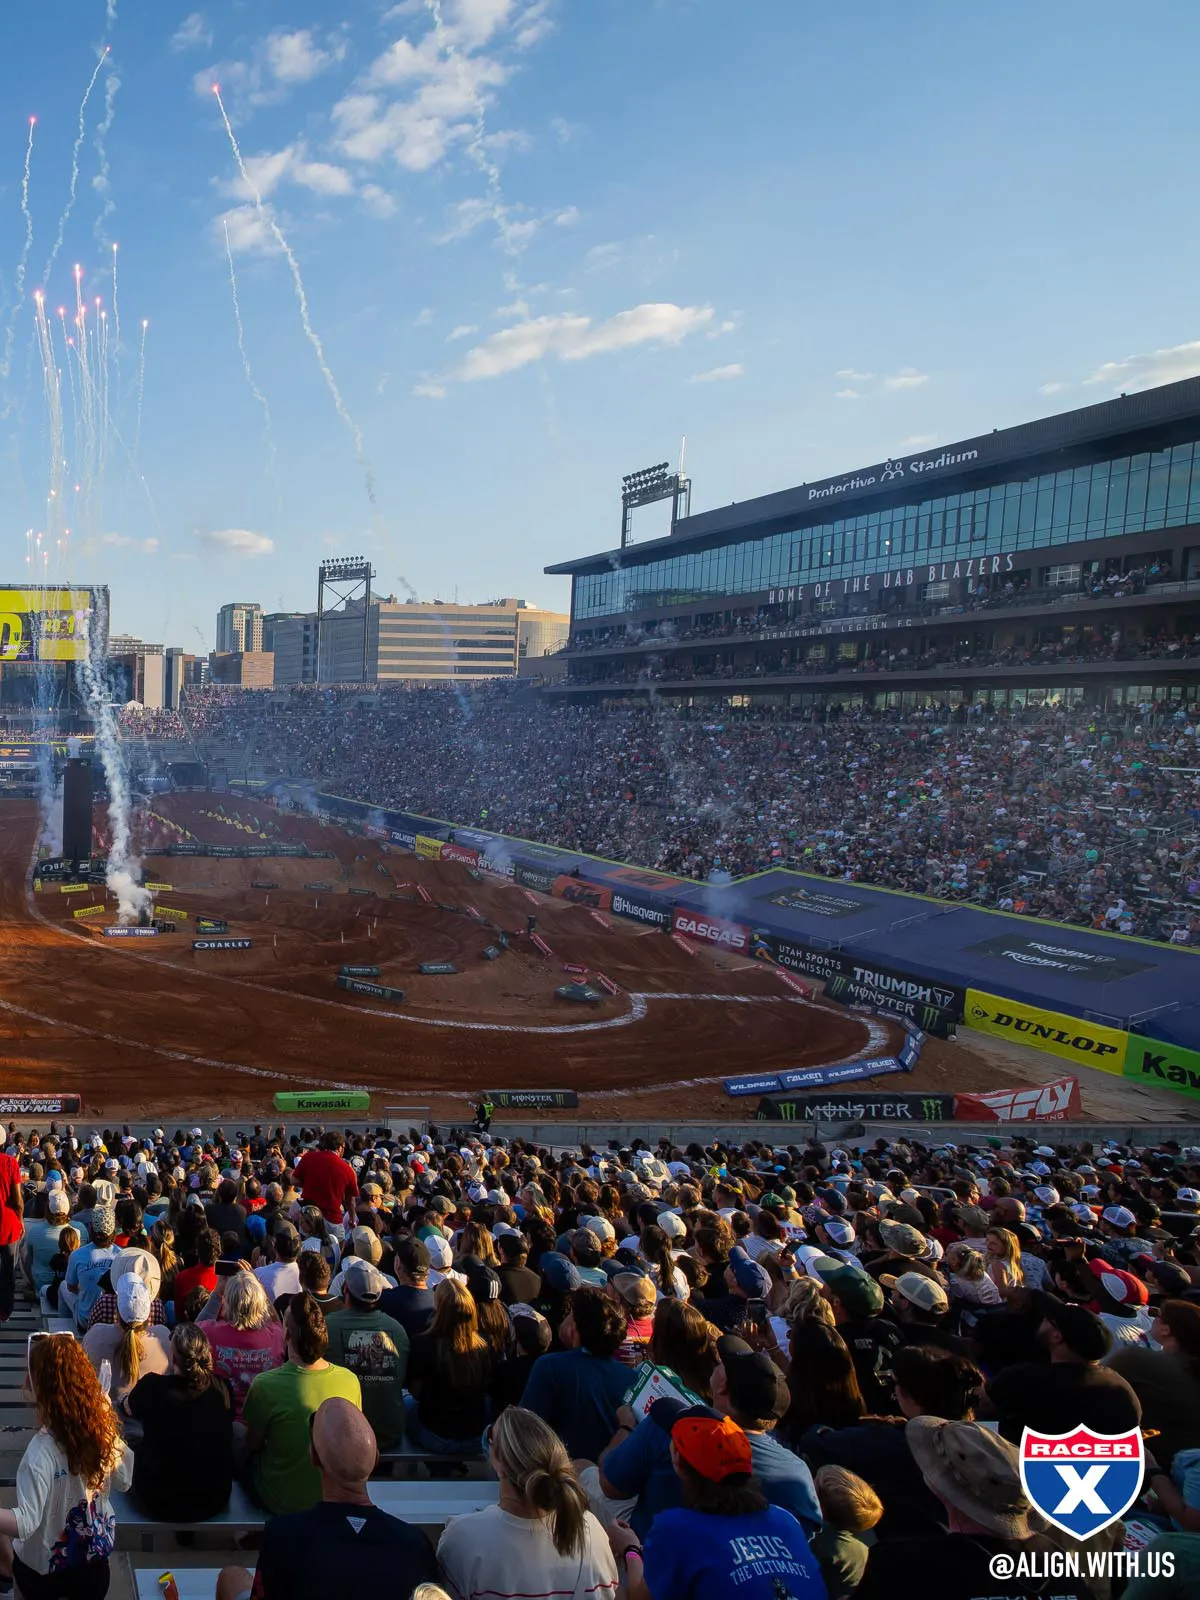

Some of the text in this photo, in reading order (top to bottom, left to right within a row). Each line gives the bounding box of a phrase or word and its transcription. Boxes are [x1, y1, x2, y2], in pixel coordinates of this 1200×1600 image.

[808, 449, 978, 500] Protective Stadium
[769, 554, 1014, 604] HOME OF THE UAB BLAZERS
[760, 619, 912, 640] BIRMINGHAM LEGION FC
[621, 898, 667, 923] Husqvarn
[210, 941, 250, 949] OAKLEY
[675, 916, 747, 948] GASGAS
[779, 944, 841, 970] UTAH SPORTS
[1001, 949, 1068, 969] TRIUMPH
[1026, 941, 1094, 961] TRIUMPH
[777, 954, 832, 979] COMMISSIO
[853, 966, 932, 1003] TRIUMPH
[848, 983, 916, 1017] MONSTER
[991, 1012, 1118, 1056] DUNLOP
[730, 1081, 777, 1090] WILDPEAK
[786, 1072, 822, 1082] FALKEN
[867, 1059, 896, 1069] FALKEN
[297, 1099, 351, 1109] Kawasaki
[511, 1094, 554, 1103] MONSTER
[805, 1101, 912, 1122] MONSTER
[979, 1081, 1074, 1120] FLY
[729, 1535, 793, 1565] JESUS
[730, 1560, 810, 1586] THE ULTIMATE
